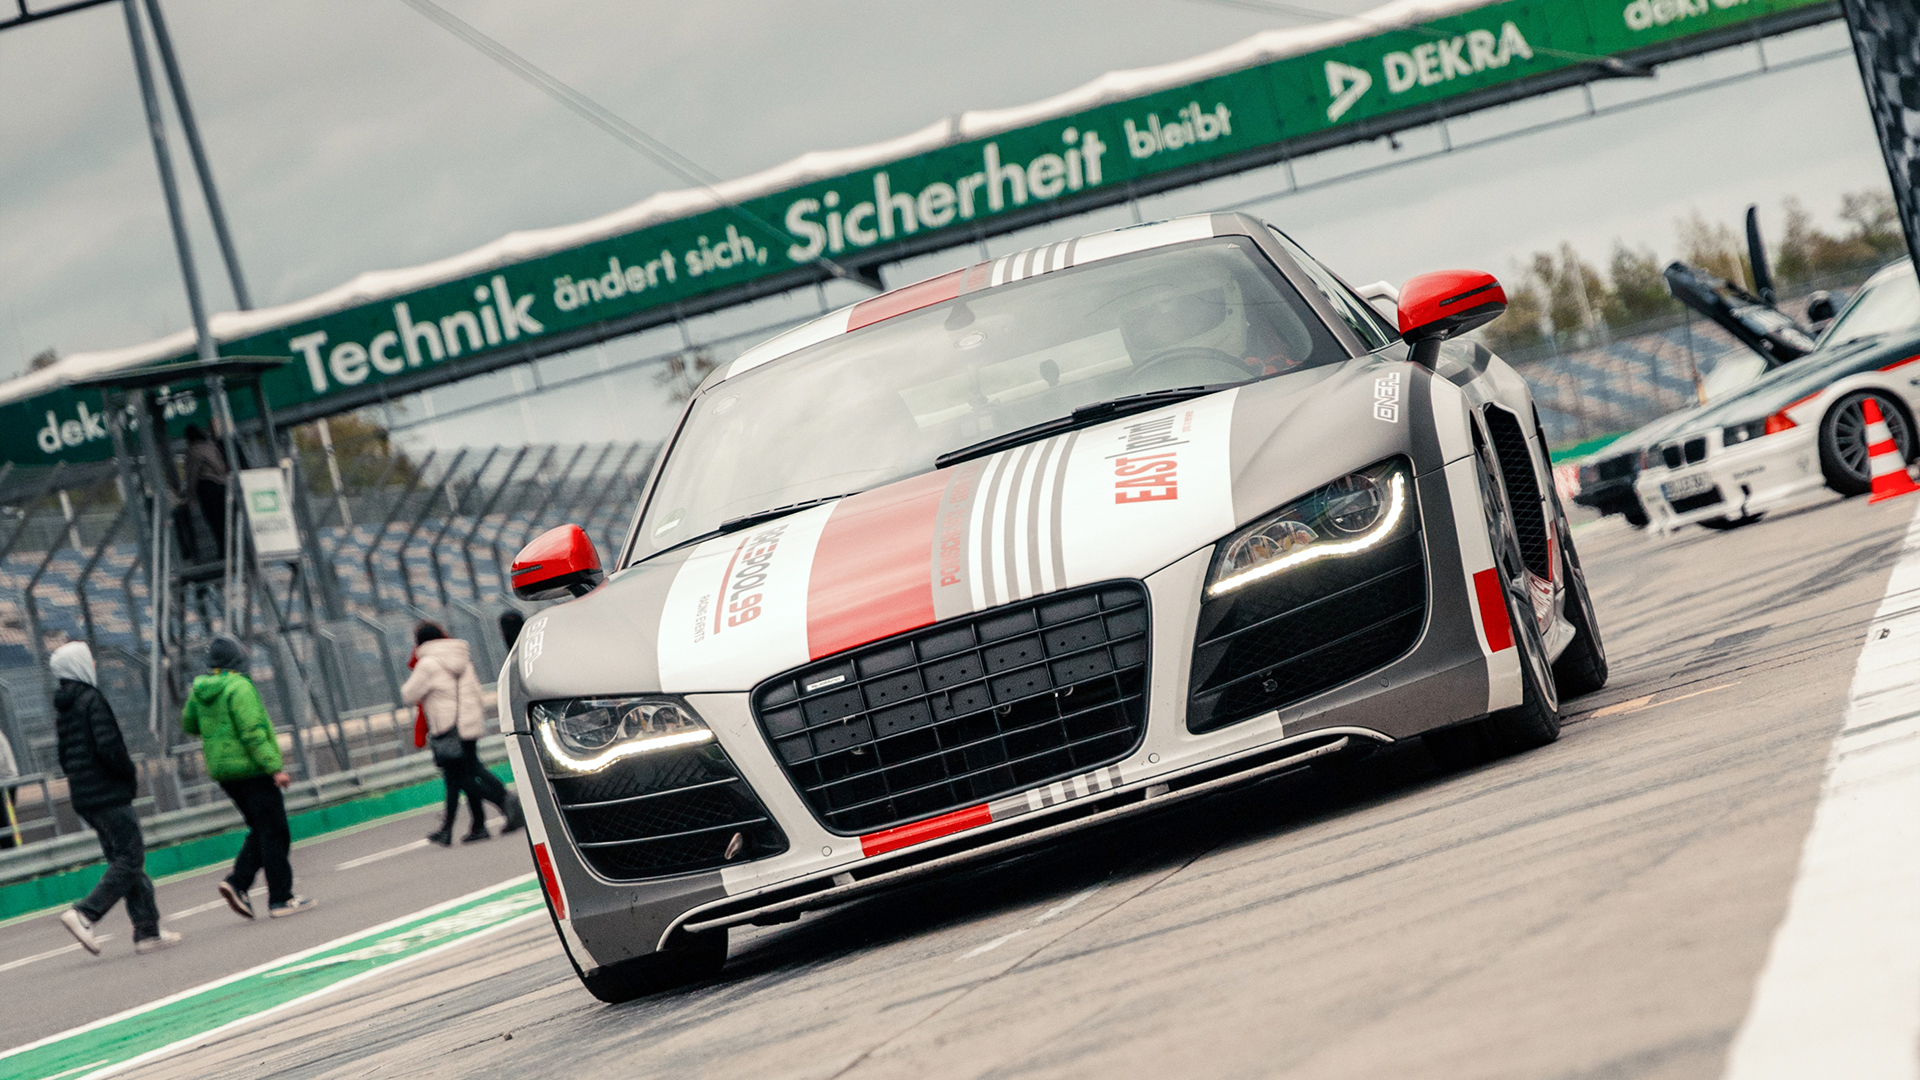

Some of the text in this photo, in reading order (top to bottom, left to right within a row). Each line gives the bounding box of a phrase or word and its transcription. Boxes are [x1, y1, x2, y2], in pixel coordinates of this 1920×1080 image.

[1382, 20, 1534, 93] DEKRA
[289, 101, 1232, 394] Technik ändert sich, Sicherheit bleibt
[1114, 452, 1178, 505] EAST
